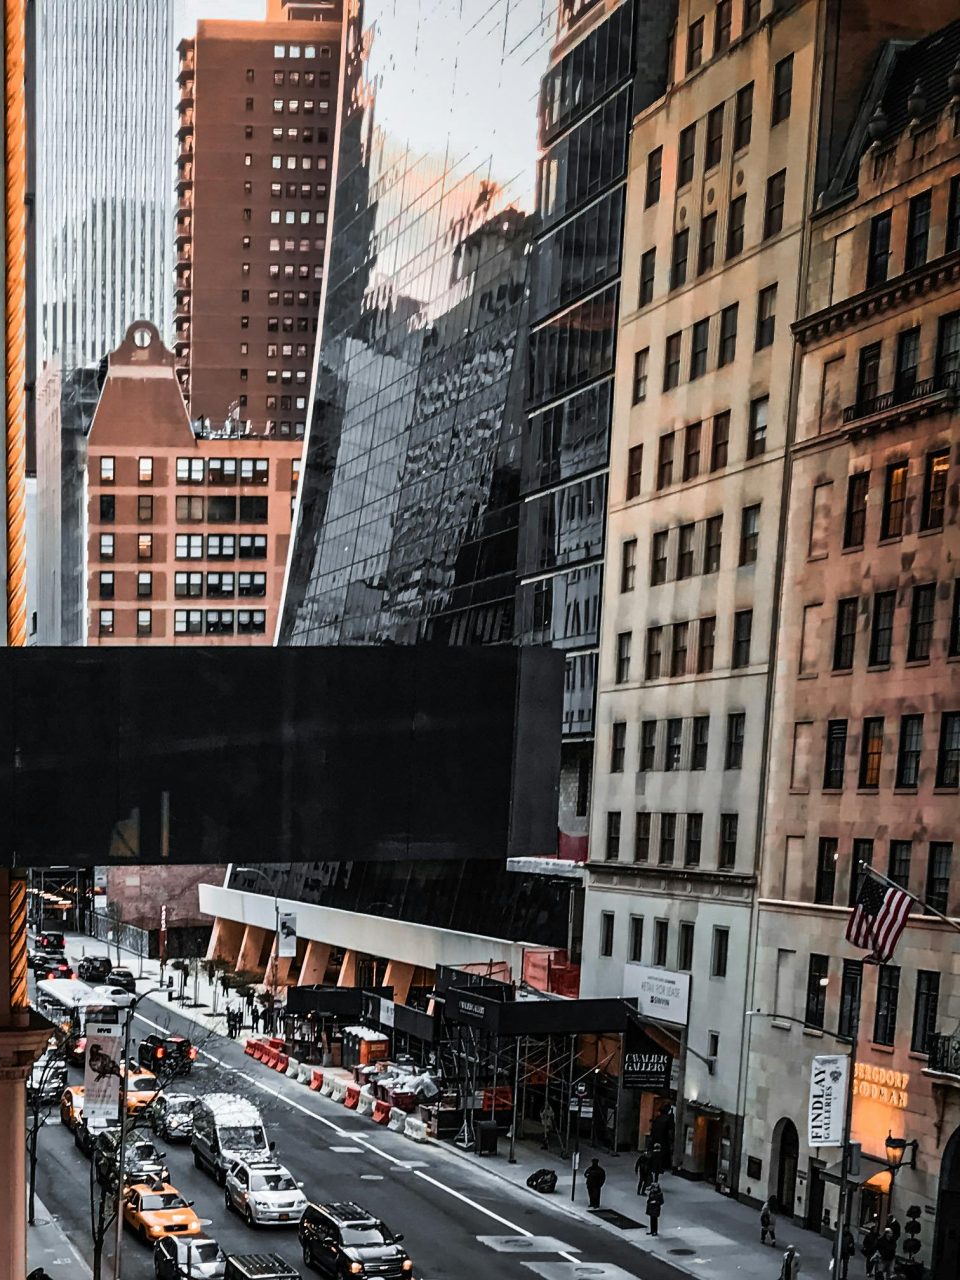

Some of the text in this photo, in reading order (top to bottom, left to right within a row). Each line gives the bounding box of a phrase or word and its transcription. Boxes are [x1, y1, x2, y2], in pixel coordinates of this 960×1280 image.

[624, 1062, 666, 1072] GALLERY
[811, 1067, 826, 1139] FINDLAY
[823, 1086, 833, 1139] GALLERIES
